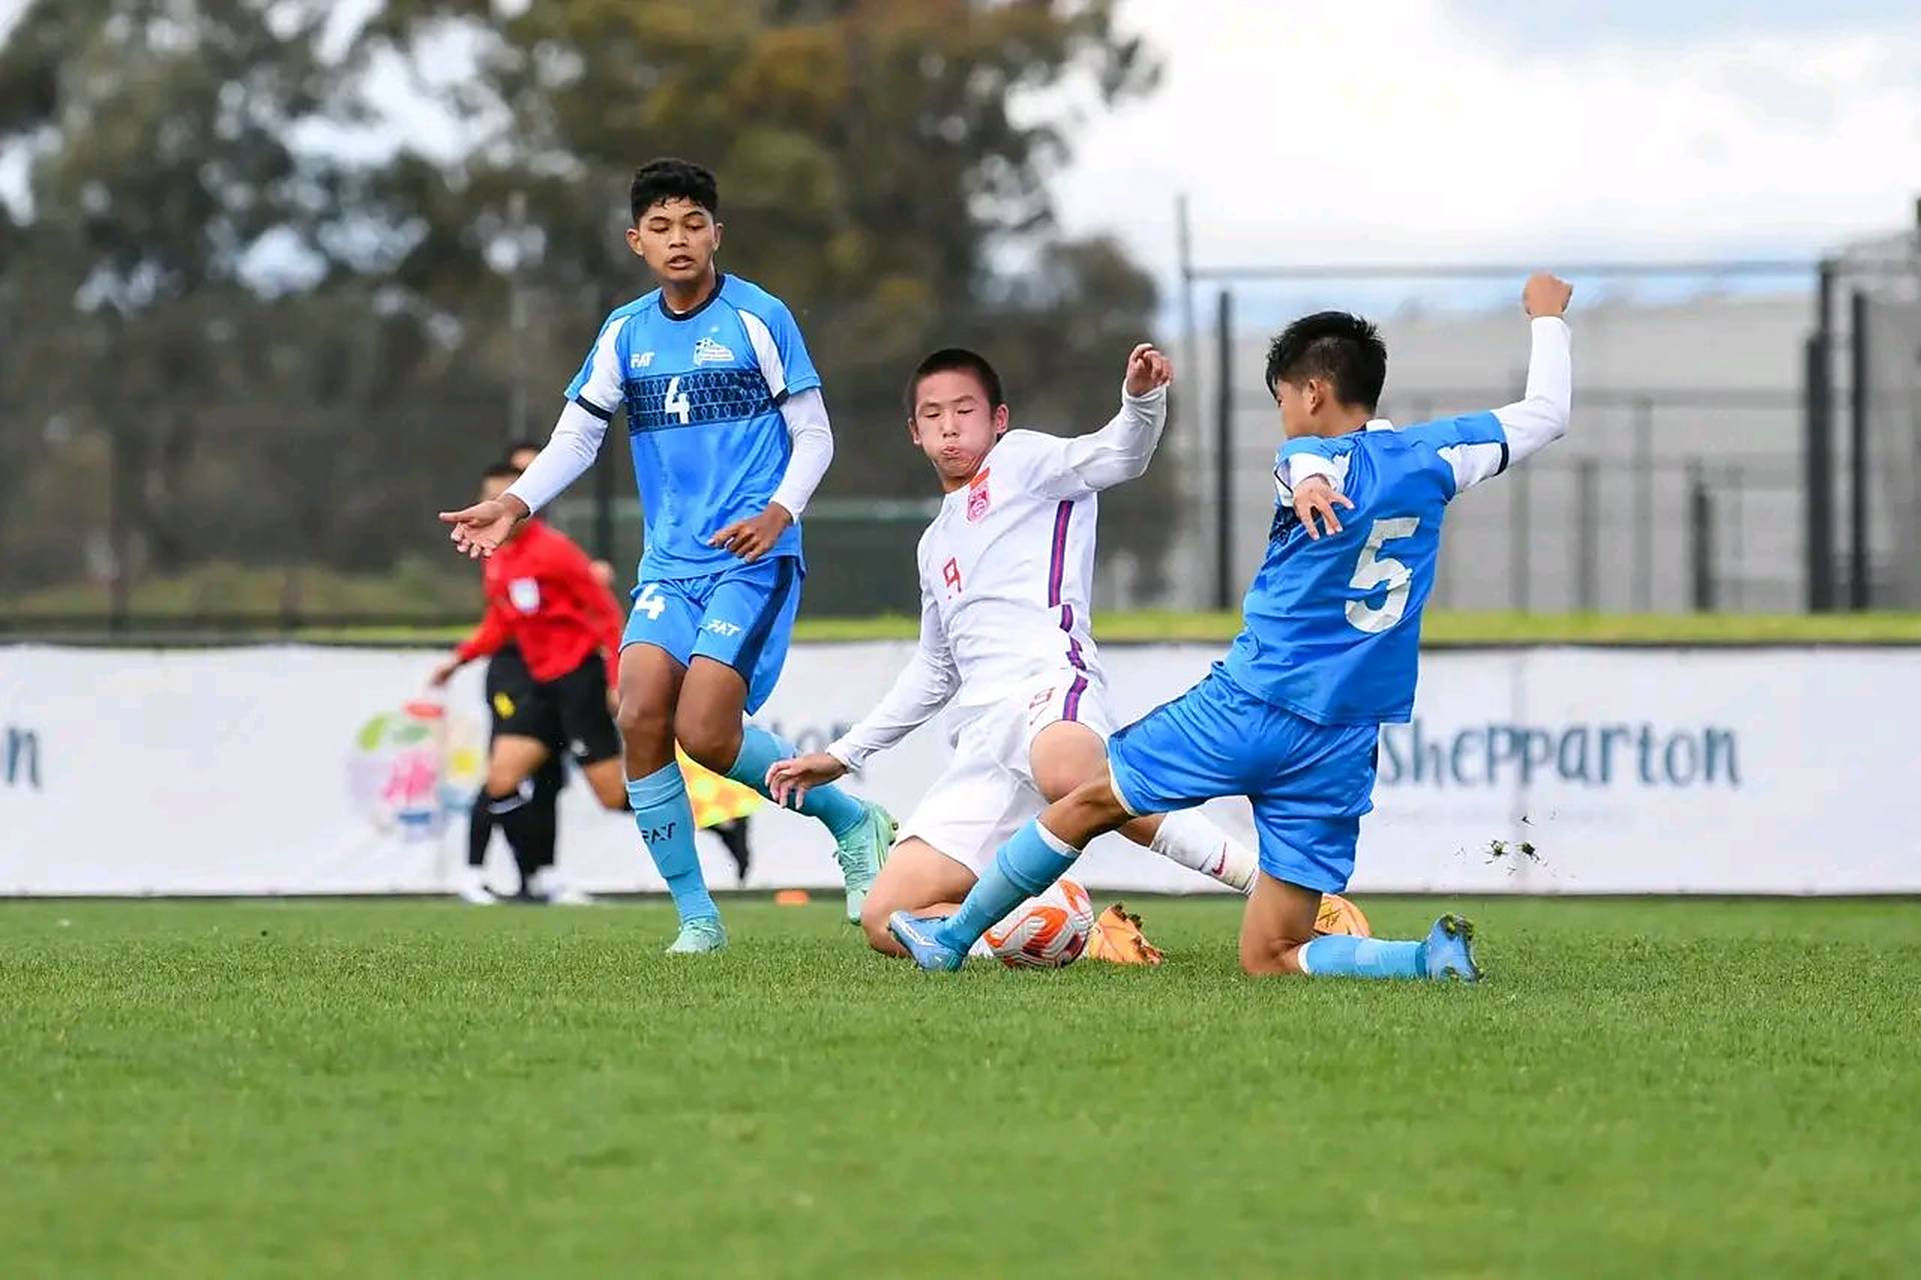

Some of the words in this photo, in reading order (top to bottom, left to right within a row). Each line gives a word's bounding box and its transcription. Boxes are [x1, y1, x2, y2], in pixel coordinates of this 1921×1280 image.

[630, 352, 655, 368] FAT
[664, 376, 690, 424] 4
[943, 556, 962, 598] 9
[1345, 516, 1420, 633] 5
[633, 583, 666, 620] 4
